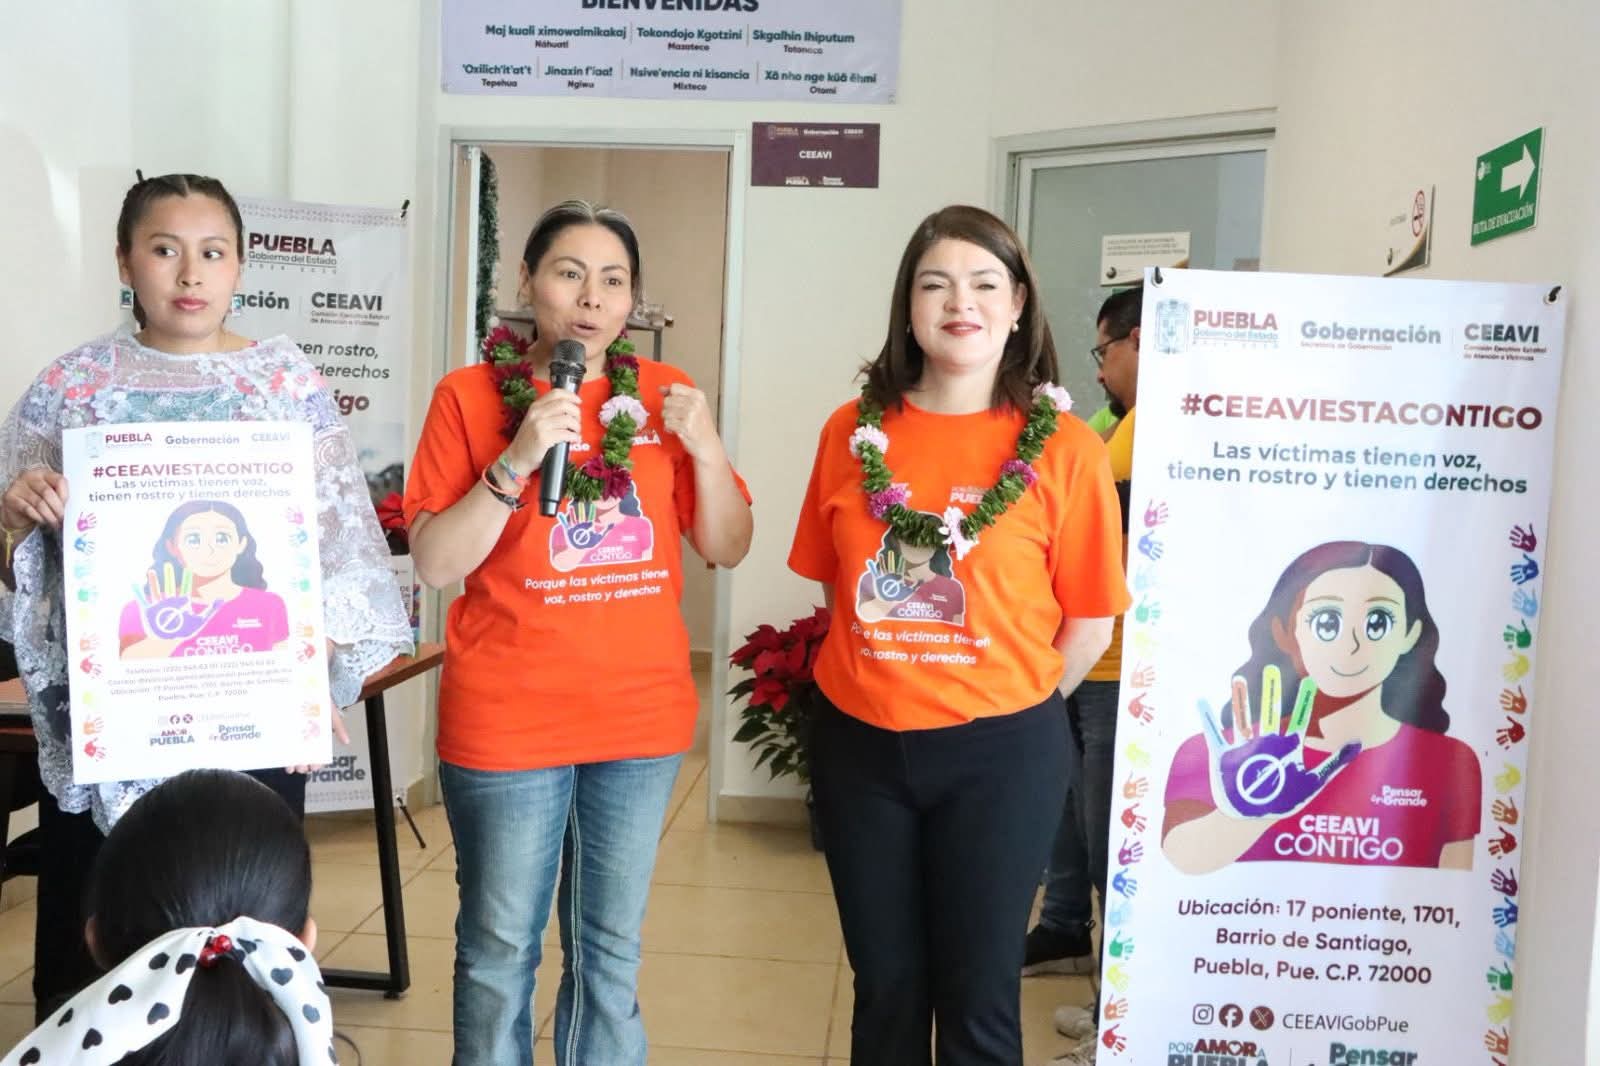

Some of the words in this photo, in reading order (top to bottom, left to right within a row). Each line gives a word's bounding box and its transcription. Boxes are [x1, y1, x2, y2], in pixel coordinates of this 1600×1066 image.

[485, 25, 506, 40] Maj
[508, 25, 535, 37] kuali
[637, 27, 694, 40] Tokondojo
[697, 29, 743, 41] Kgotzini
[705, 69, 749, 80] kisancia
[482, 79, 517, 90] Tepehua
[673, 82, 707, 91] Mixteco
[799, 150, 832, 160] CEEAVI
[249, 232, 336, 256] PUEBLA
[249, 251, 290, 262] Gobierno
[291, 255, 305, 263] del
[306, 256, 337, 266] Estado
[311, 291, 382, 311] CEEAVI
[1193, 309, 1278, 331] PUEBLA
[1193, 327, 1232, 339] Gobierno
[1248, 330, 1279, 341] Estado
[1301, 320, 1442, 344] Gobernación
[1464, 322, 1540, 343] CEEAVI
[327, 344, 378, 360] rostro,
[315, 363, 390, 379] derechos
[1180, 392, 1543, 431] #CEEAVIESTACONTIGO
[105, 432, 153, 443] PUEBLA
[164, 434, 240, 445] Gobernación
[1213, 441, 1251, 460] Las
[1258, 441, 1357, 465] víctimas
[1363, 445, 1436, 468] tienen
[1442, 451, 1482, 473] voz,
[93, 462, 294, 479] #CEEAVIESTACONTIGO
[1166, 461, 1242, 482] tienen
[1248, 467, 1318, 486] rostro
[1322, 472, 1338, 491] y
[1343, 469, 1418, 490] tienen
[1423, 472, 1527, 495] derechos
[114, 480, 137, 489] Las
[199, 476, 240, 488] tienen
[89, 489, 133, 503] tienen
[136, 487, 176, 500] rostro
[178, 489, 186, 502] y
[189, 484, 232, 498] tienen
[235, 481, 291, 497] derechos
[525, 577, 566, 592] Porque
[569, 575, 587, 588] las
[544, 593, 566, 605] voz,
[569, 591, 602, 601] rostro
[604, 591, 613, 602] y
[615, 584, 661, 599] derechos
[897, 608, 943, 618] CONTIGO
[873, 628, 892, 641] las
[911, 654, 918, 664] y
[920, 652, 976, 665] derechos
[218, 724, 256, 736] Pensar
[219, 731, 262, 743] Grande
[150, 734, 195, 747] PUEBLA
[1382, 785, 1423, 799] Pensar
[1384, 796, 1427, 807] Grande
[1299, 813, 1379, 836] CEEAVI
[1274, 832, 1404, 860] CONTIGO
[1177, 898, 1280, 917] Ubicación:
[1286, 900, 1306, 917] 17
[1312, 904, 1407, 924] poniente,
[1413, 905, 1460, 928] 1701,
[1215, 928, 1277, 946] Barrio
[1283, 931, 1309, 948] de
[1315, 933, 1412, 956] Santiago,
[1193, 957, 1269, 980] Puebla,
[1276, 961, 1319, 981] Pue.
[1325, 964, 1362, 982] C.P.
[1368, 965, 1432, 985] 72000
[1282, 1012, 1409, 1034] CEEAVIGobPue
[1168, 1041, 1194, 1054] POR
[1194, 1038, 1257, 1057] AMOR
[1329, 1041, 1418, 1066] Pensar
